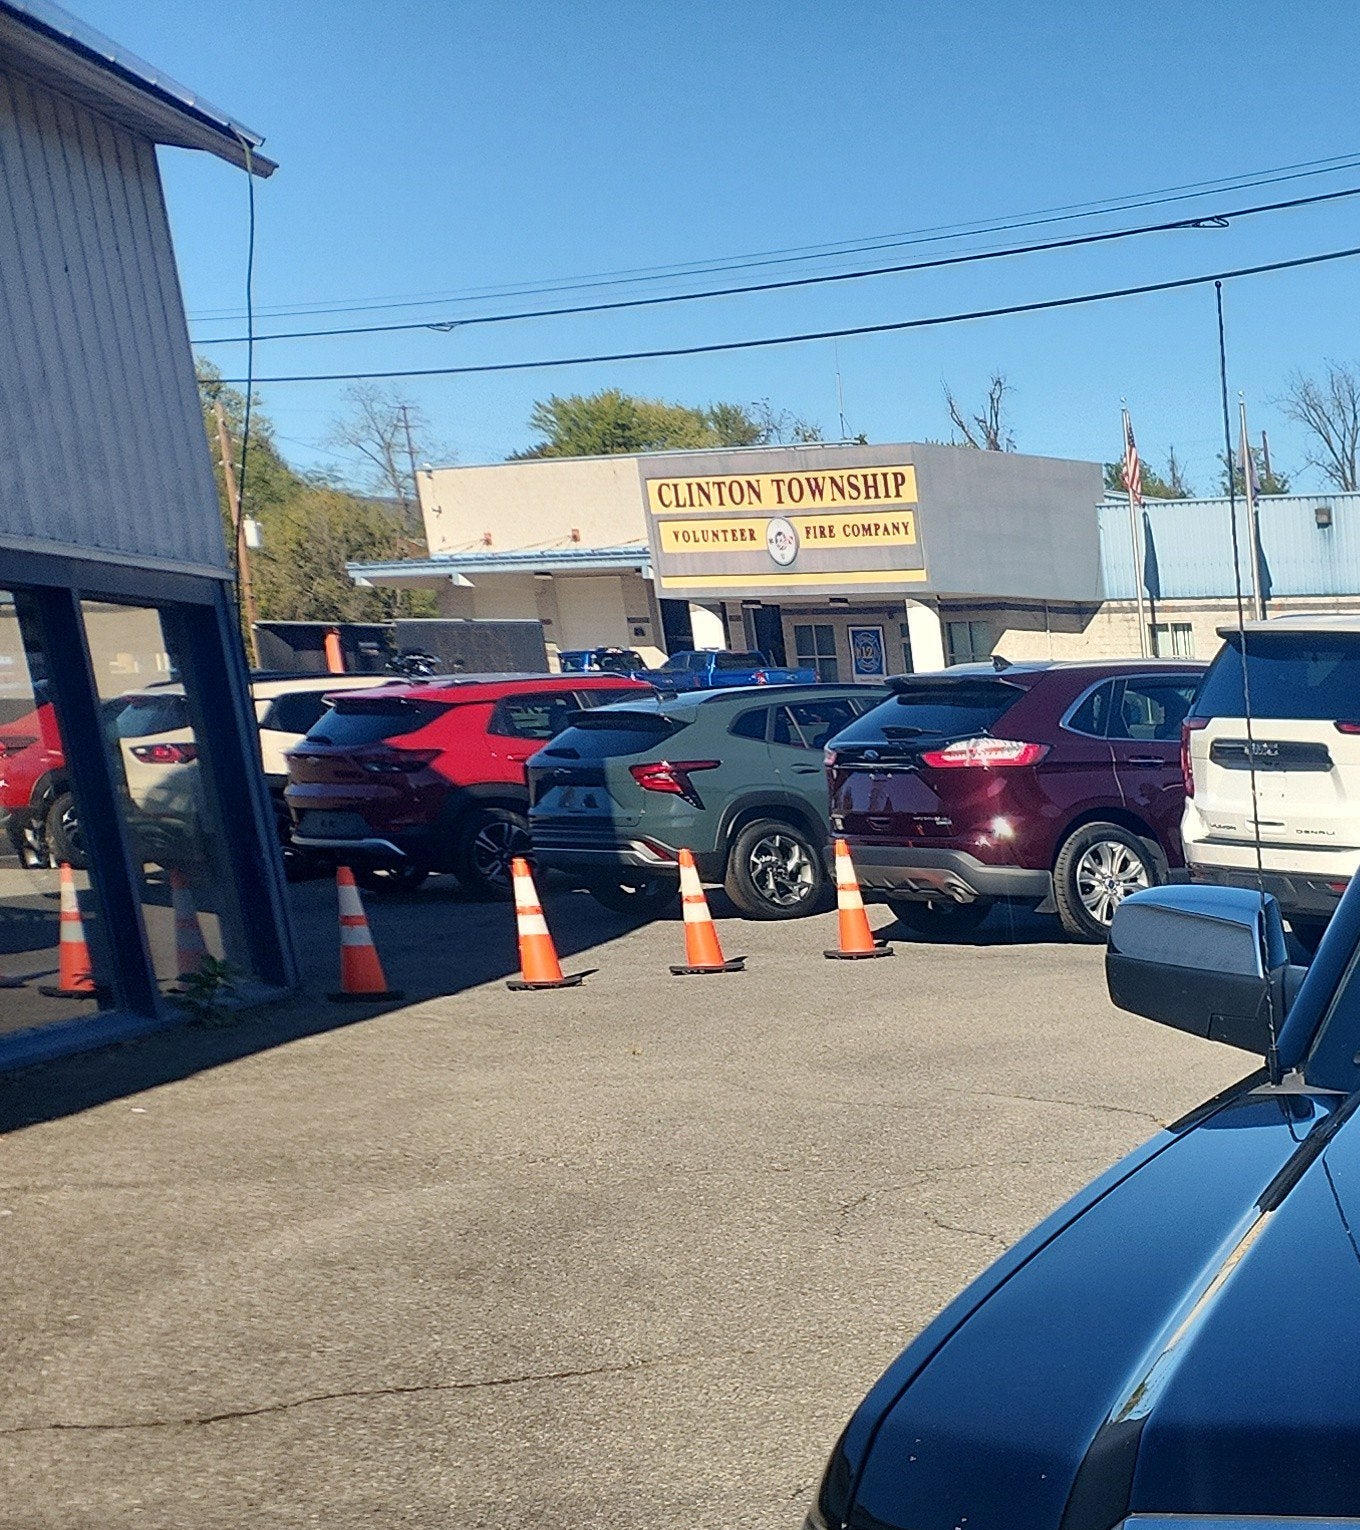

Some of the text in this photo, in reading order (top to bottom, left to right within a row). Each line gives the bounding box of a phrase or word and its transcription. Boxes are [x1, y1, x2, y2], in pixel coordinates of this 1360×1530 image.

[657, 471, 907, 508] CLINTON TOWNSHIP
[672, 521, 911, 543] VOLUNTEER FIRE COMPANY
